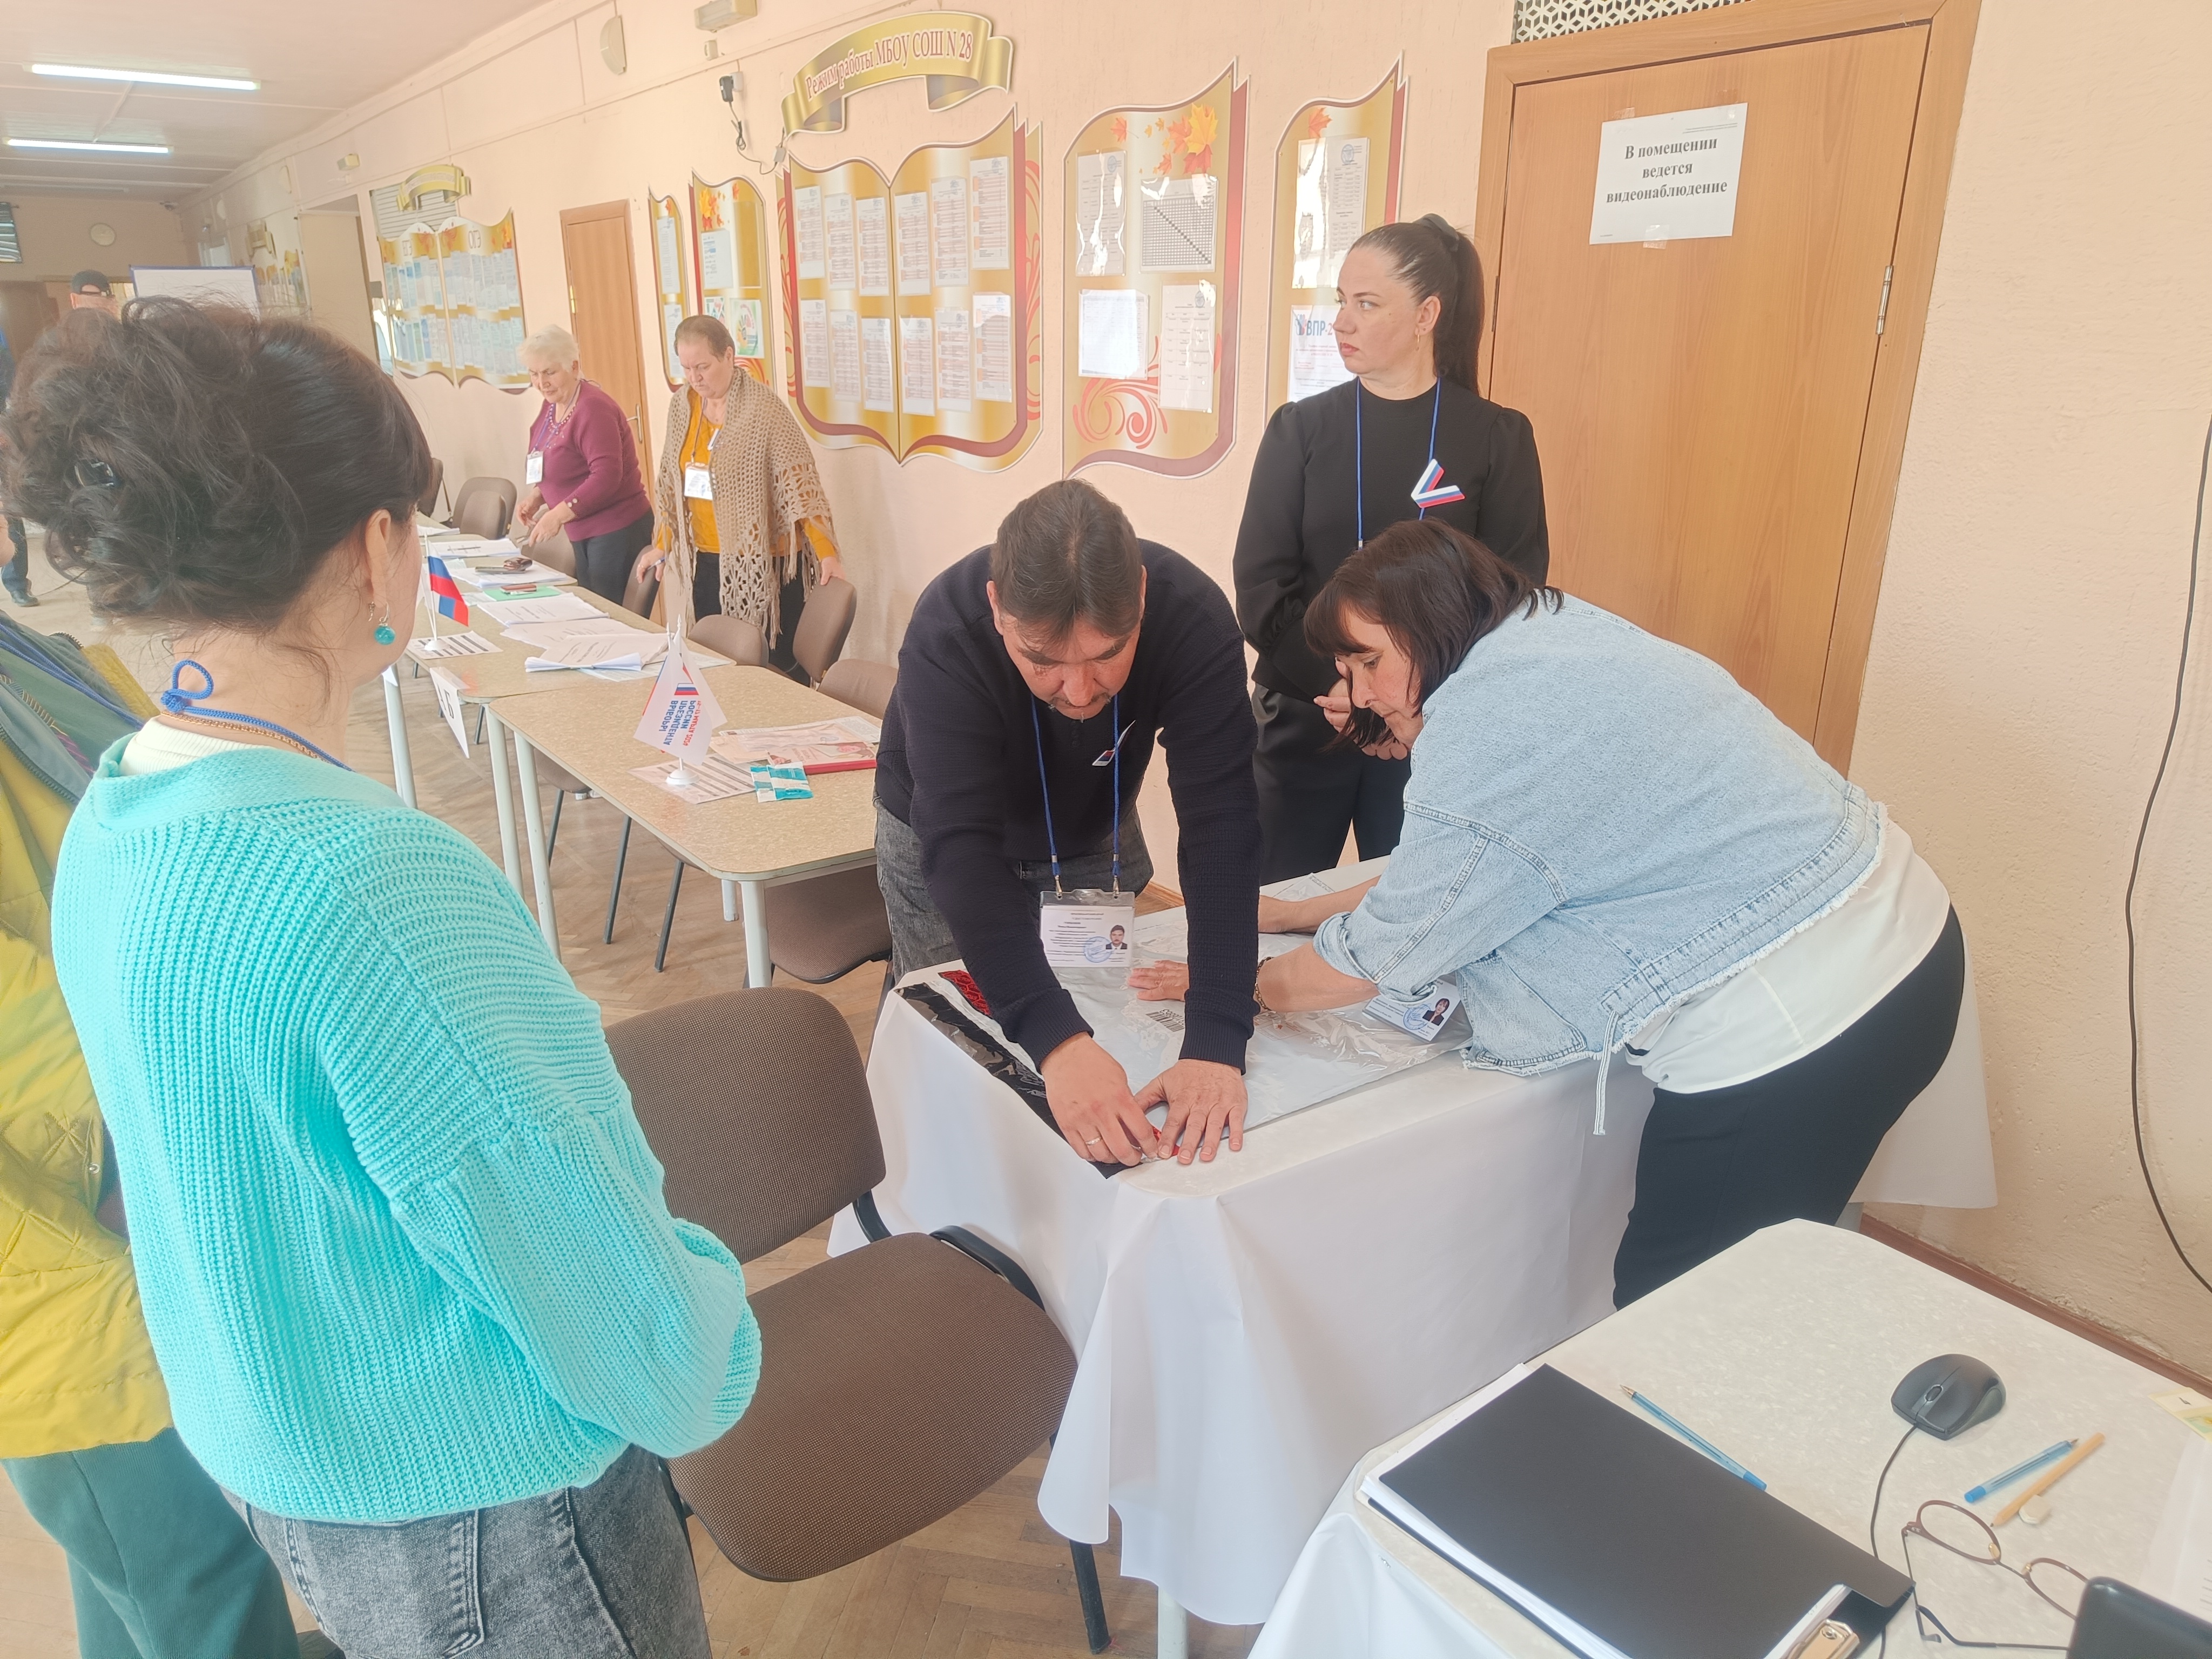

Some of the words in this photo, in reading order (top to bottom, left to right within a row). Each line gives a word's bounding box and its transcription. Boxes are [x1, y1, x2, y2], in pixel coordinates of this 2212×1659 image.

[806, 65, 838, 99] Режим
[839, 51, 874, 86] работы
[875, 35, 910, 66] МБОУ
[913, 31, 943, 57] СОШ
[959, 32, 972, 59] 28
[1624, 145, 1634, 159] В
[1638, 138, 1717, 158] помещении
[1642, 163, 1693, 179] ведется
[1606, 181, 1728, 203] видеонаблюдение
